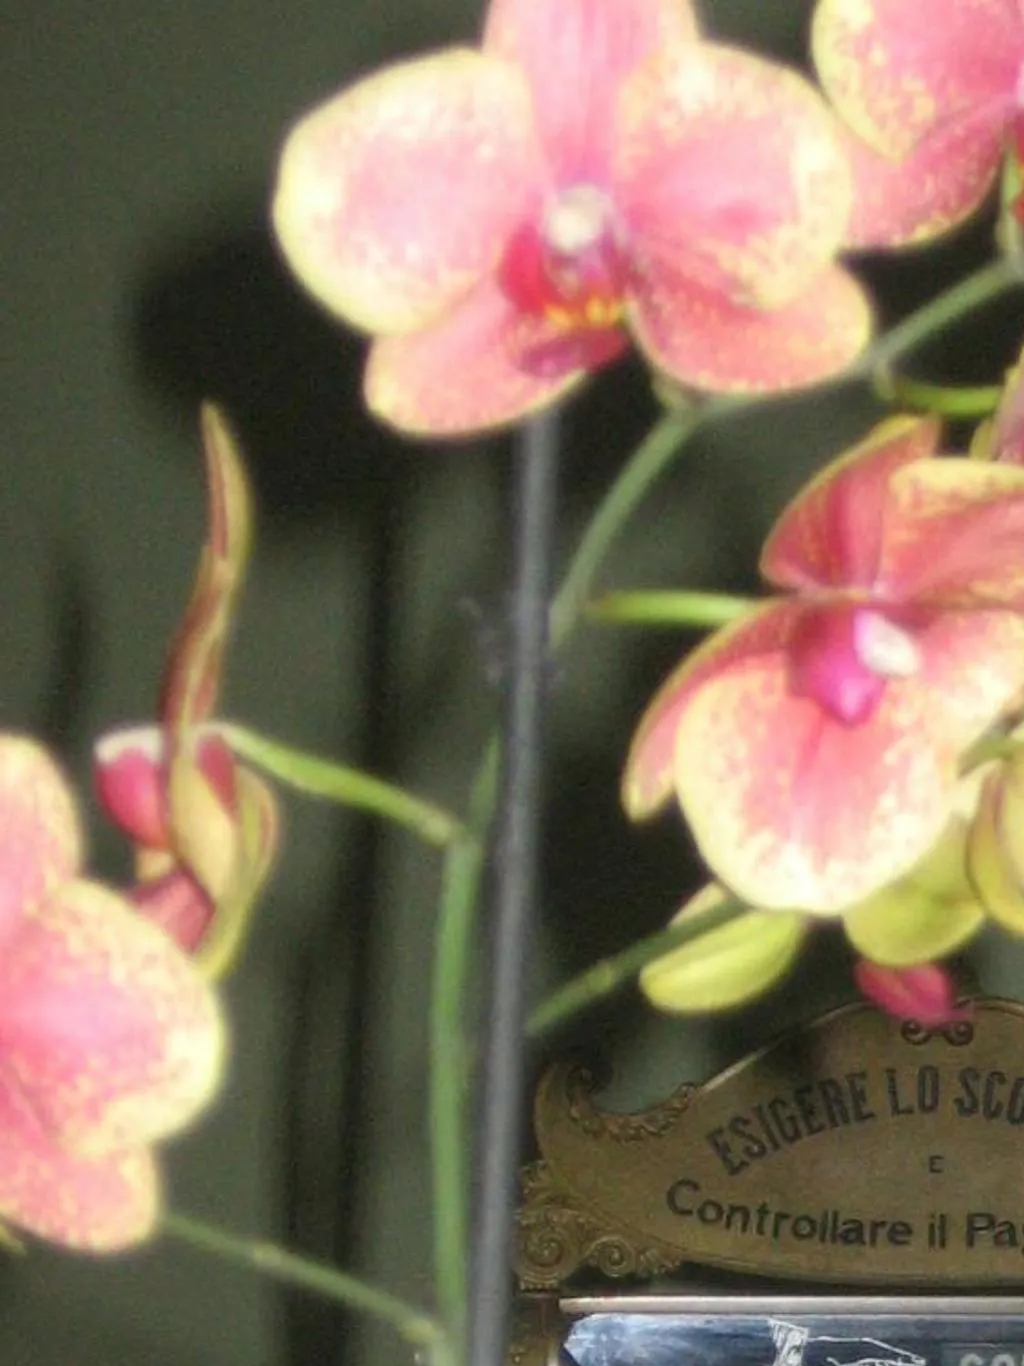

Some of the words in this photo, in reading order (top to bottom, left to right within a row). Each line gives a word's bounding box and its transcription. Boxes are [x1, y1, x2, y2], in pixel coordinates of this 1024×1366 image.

[706, 1071, 876, 1176] ESIGERE
[887, 1066, 939, 1116] LO
[928, 1155, 944, 1173] E
[666, 1179, 913, 1249] Controllare
[926, 1213, 948, 1249] il
